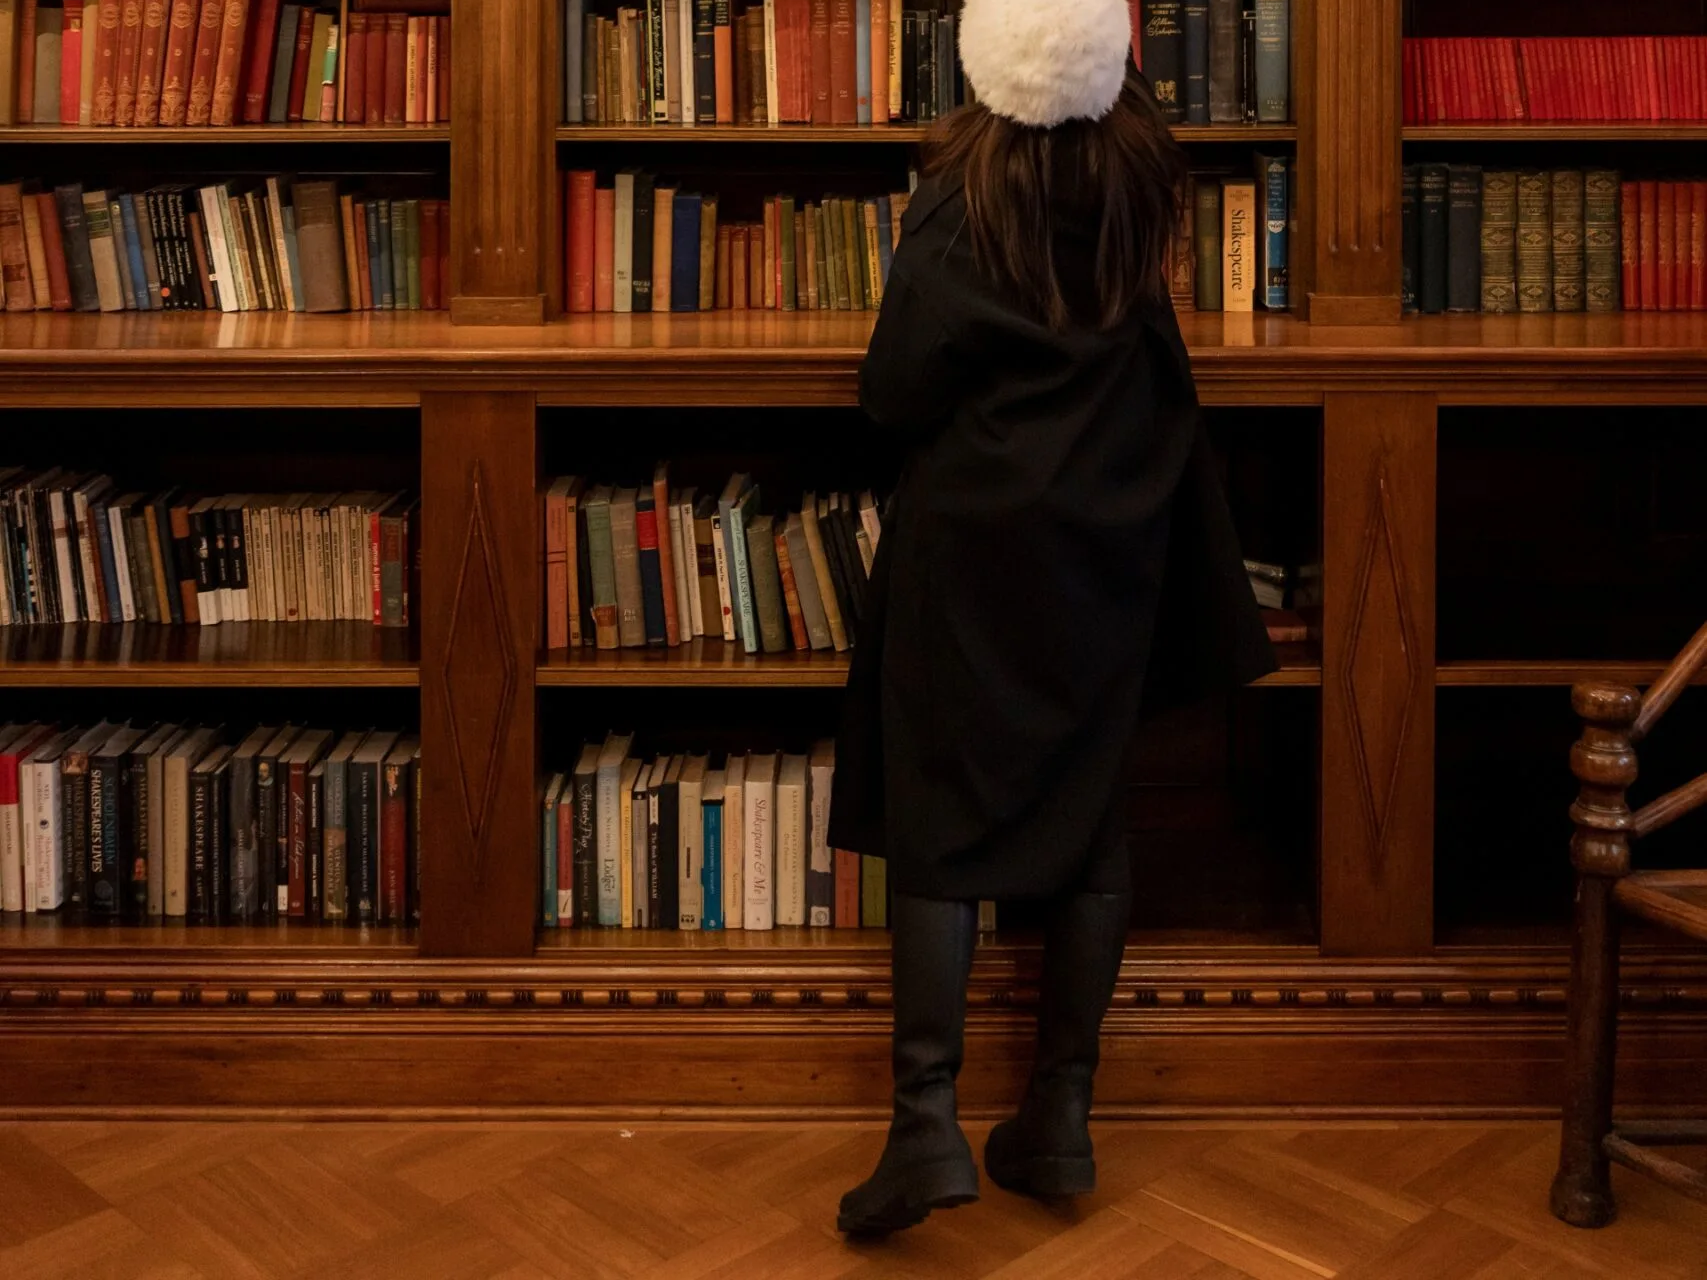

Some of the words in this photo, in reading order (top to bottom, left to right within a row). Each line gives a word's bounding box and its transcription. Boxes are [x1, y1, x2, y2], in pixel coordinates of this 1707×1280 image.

[1227, 208, 1246, 290] Shakespeare
[738, 559, 751, 617] SHAKESPEARE
[90, 769, 103, 843] SHAKESPEARE'S
[104, 776, 116, 865] SCHOENBAUM
[139, 777, 147, 851] SHAKESPEARE
[195, 786, 204, 871] SHAKESPEARE
[578, 784, 593, 826] History
[751, 798, 767, 859] Shakespeare
[91, 845, 103, 873] LIVES
[576, 827, 592, 853] Play
[754, 861, 765, 875] &
[601, 858, 614, 894] Lodger
[754, 877, 765, 894] Me
